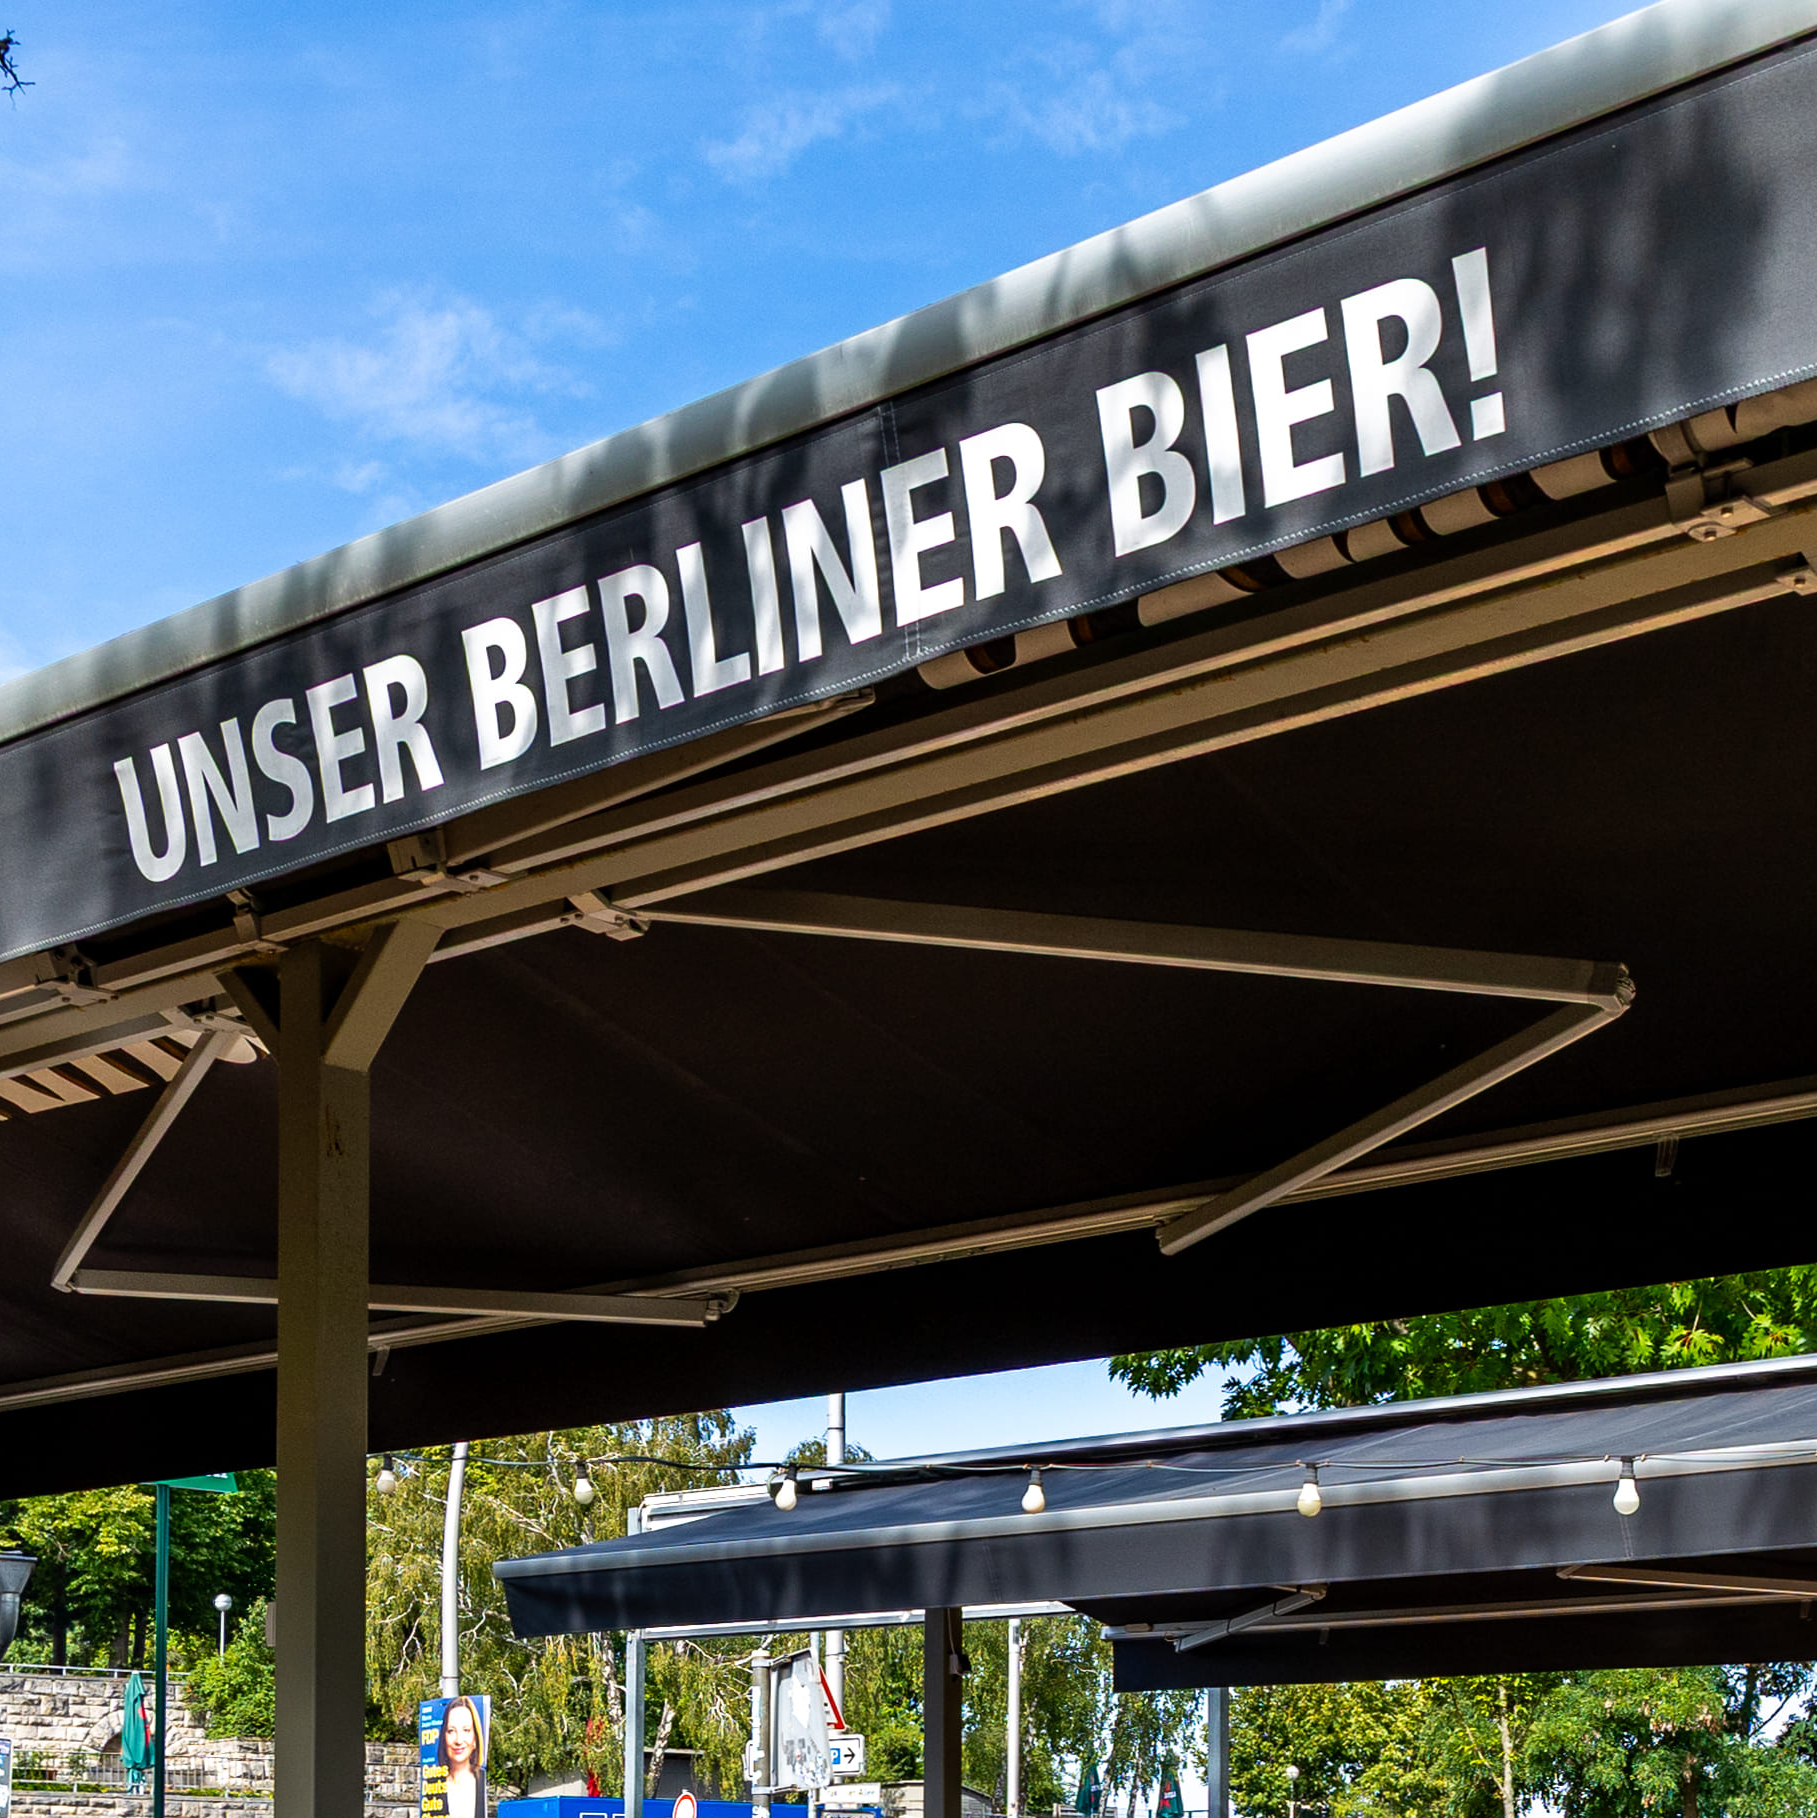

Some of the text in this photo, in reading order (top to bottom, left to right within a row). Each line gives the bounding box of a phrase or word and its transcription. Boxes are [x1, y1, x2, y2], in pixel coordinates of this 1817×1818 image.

[114, 247, 1506, 882] UNSER BERLINER BIER!
[421, 1728, 440, 1746] FDP
[422, 1764, 449, 1779] Gutes
[421, 1796, 444, 1812] Gute
